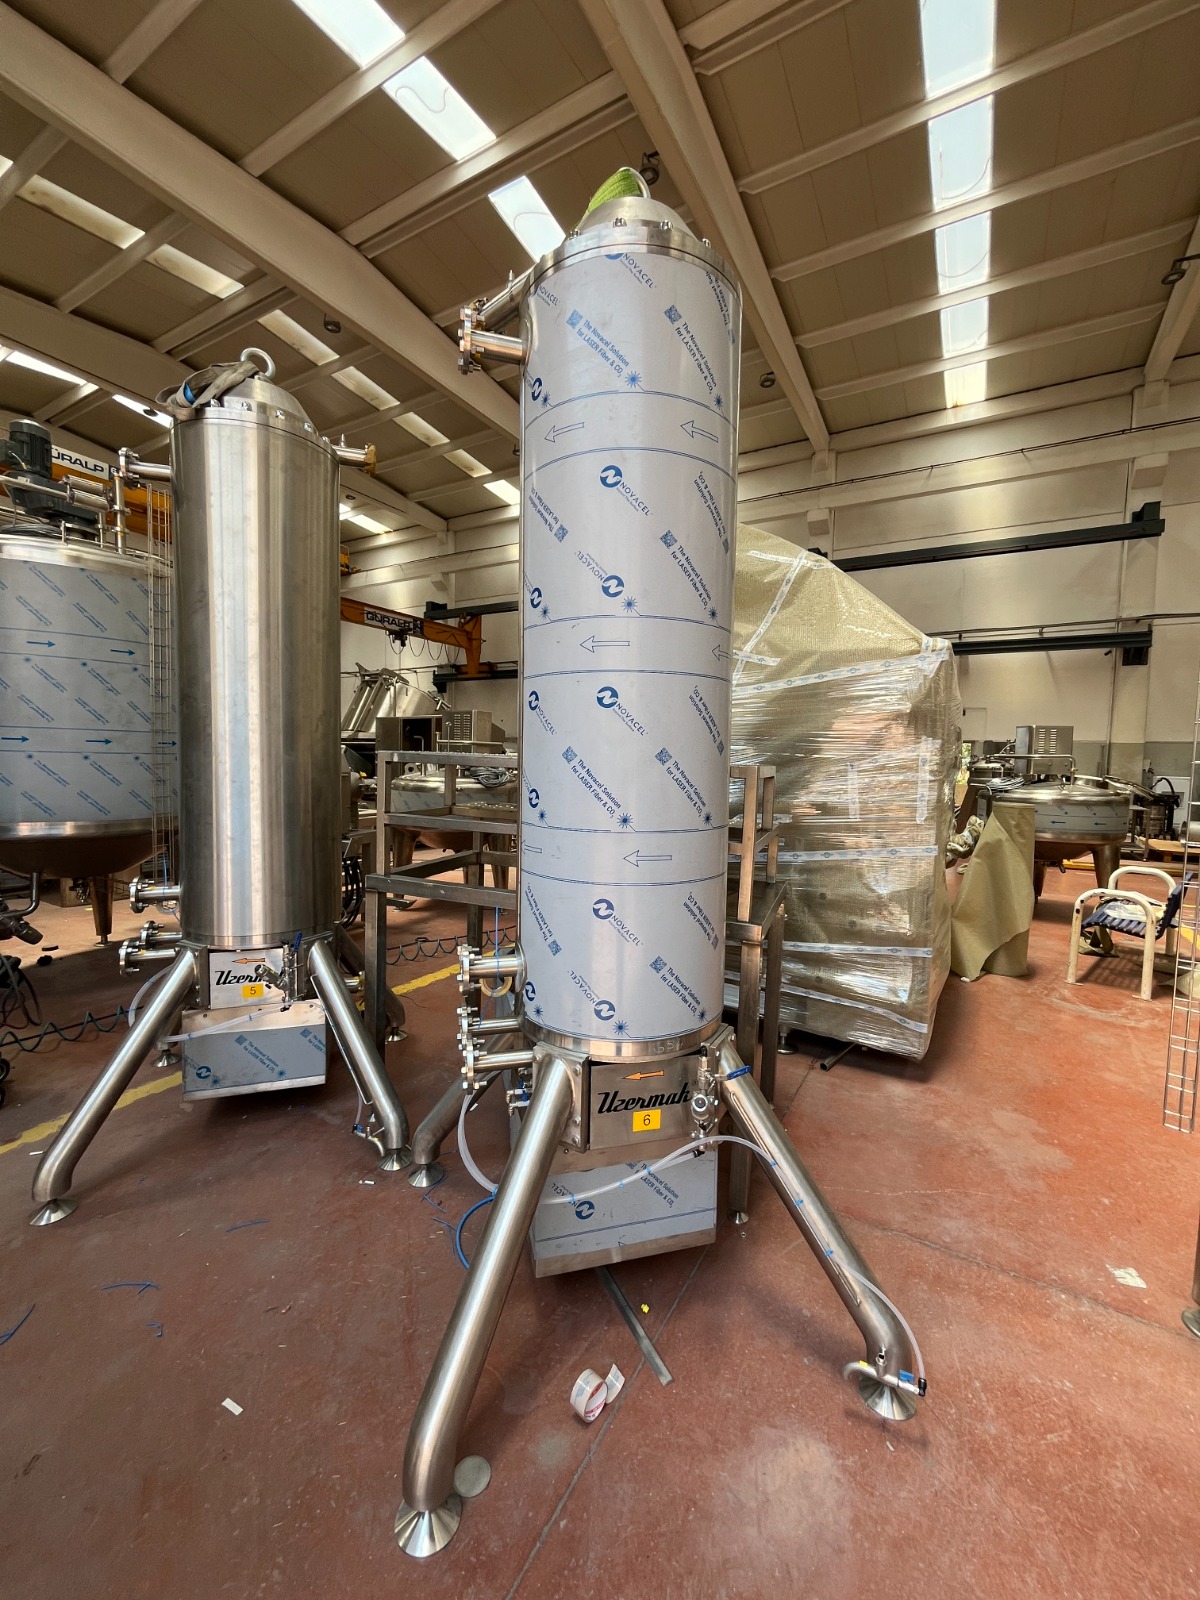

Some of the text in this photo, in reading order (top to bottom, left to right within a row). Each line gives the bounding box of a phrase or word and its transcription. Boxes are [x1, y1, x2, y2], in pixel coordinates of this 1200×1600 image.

[624, 253, 654, 289] NOVACEL
[577, 328, 585, 338] for
[583, 334, 599, 351] LASER
[598, 348, 611, 362] Fiber
[584, 320, 630, 367] The Novacel Solution
[675, 327, 683, 337] for
[682, 337, 697, 359] LASER
[694, 358, 705, 375] Fiber
[682, 322, 717, 387] The Novacel Solution
[52, 448, 104, 472] ÜRALP
[620, 482, 650, 516] NOVACEL
[576, 550, 605, 581] NOVACEL
[671, 551, 679, 561] for
[677, 559, 692, 580] LASER
[690, 578, 700, 594] Fiber
[677, 545, 712, 602] The Novacel Solution
[537, 704, 555, 735] NOVACEL
[616, 703, 646, 736] NOVACEL
[571, 765, 579, 775] for
[577, 773, 593, 791] LASER
[591, 788, 603, 803] Fiber
[577, 759, 621, 809] The Novacel Solution
[666, 767, 674, 776] for
[672, 774, 686, 791] LASER
[684, 789, 694, 803] Fiber
[672, 760, 706, 807] The Novacel Solution
[611, 915, 640, 946] NOVACEL
[215, 970, 261, 985] Uzer
[250, 987, 256, 995] 5
[569, 970, 597, 1005] NOVACEL
[666, 980, 681, 998] LASER
[679, 993, 689, 1006] Fiber
[667, 967, 700, 1006] The Novacel Solution
[597, 1082, 692, 1114] Uzermak
[643, 1114, 651, 1126] 6
[551, 1182, 578, 1207] NACEL
[640, 1176, 655, 1188] LASER
[653, 1186, 664, 1196] Fiber
[663, 1183, 679, 1199] Solution
